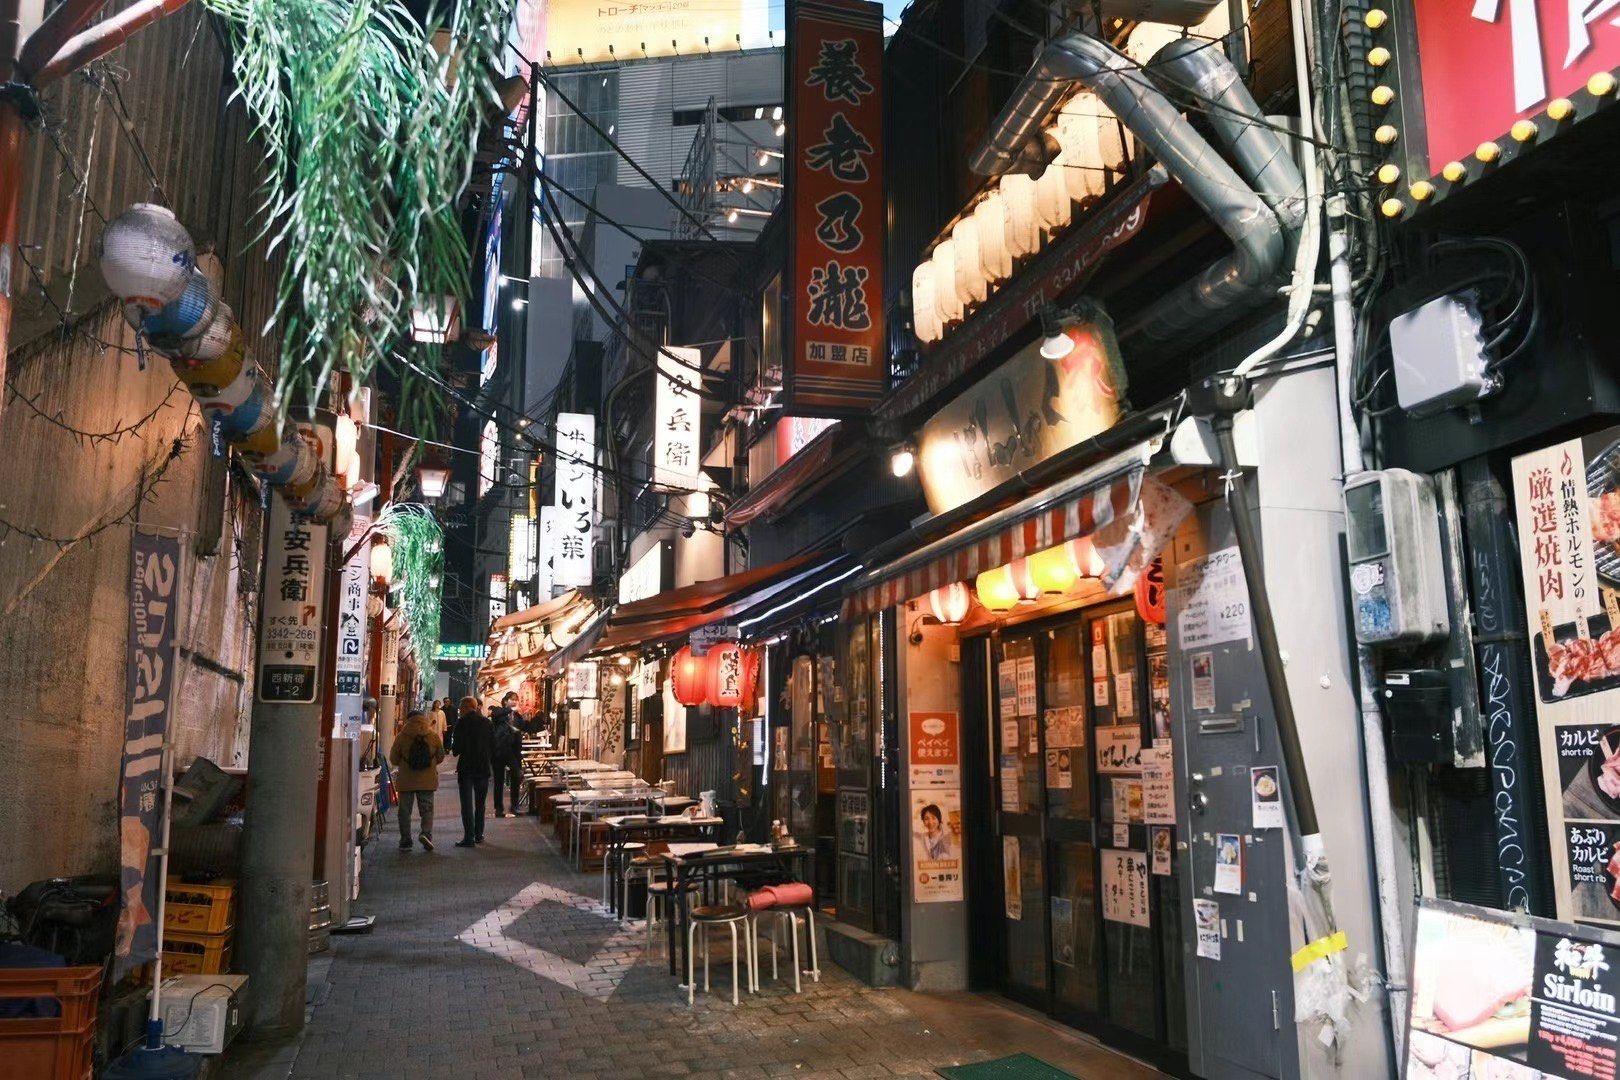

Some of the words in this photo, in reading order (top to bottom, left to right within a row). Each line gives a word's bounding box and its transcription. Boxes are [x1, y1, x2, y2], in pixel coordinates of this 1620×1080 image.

[805, 38, 874, 332] 養老乃瀧
[809, 342, 869, 364] 加盟店
[666, 374, 691, 466] 安兵衛
[561, 489, 591, 560] いろ葉
[1528, 467, 1565, 602] 厳選焼肉
[1560, 479, 1586, 599] 情熱ホルモンの
[1220, 602, 1245, 619] ¥220
[267, 628, 316, 641] 3342-2661
[271, 673, 305, 684] 西新宿
[273, 686, 300, 696] 1-2
[342, 684, 356, 693] 1-2
[1561, 729, 1600, 746] カルビ
[1561, 748, 1581, 756] short
[1582, 747, 1593, 756] rib
[1571, 827, 1606, 846] あぶり
[1573, 847, 1608, 864] カルビ
[1573, 864, 1595, 874] Roast
[1574, 873, 1594, 882] short
[1595, 874, 1606, 883] rib
[1554, 938, 1610, 981] 和牛
[1543, 973, 1616, 1014] Sirloin
